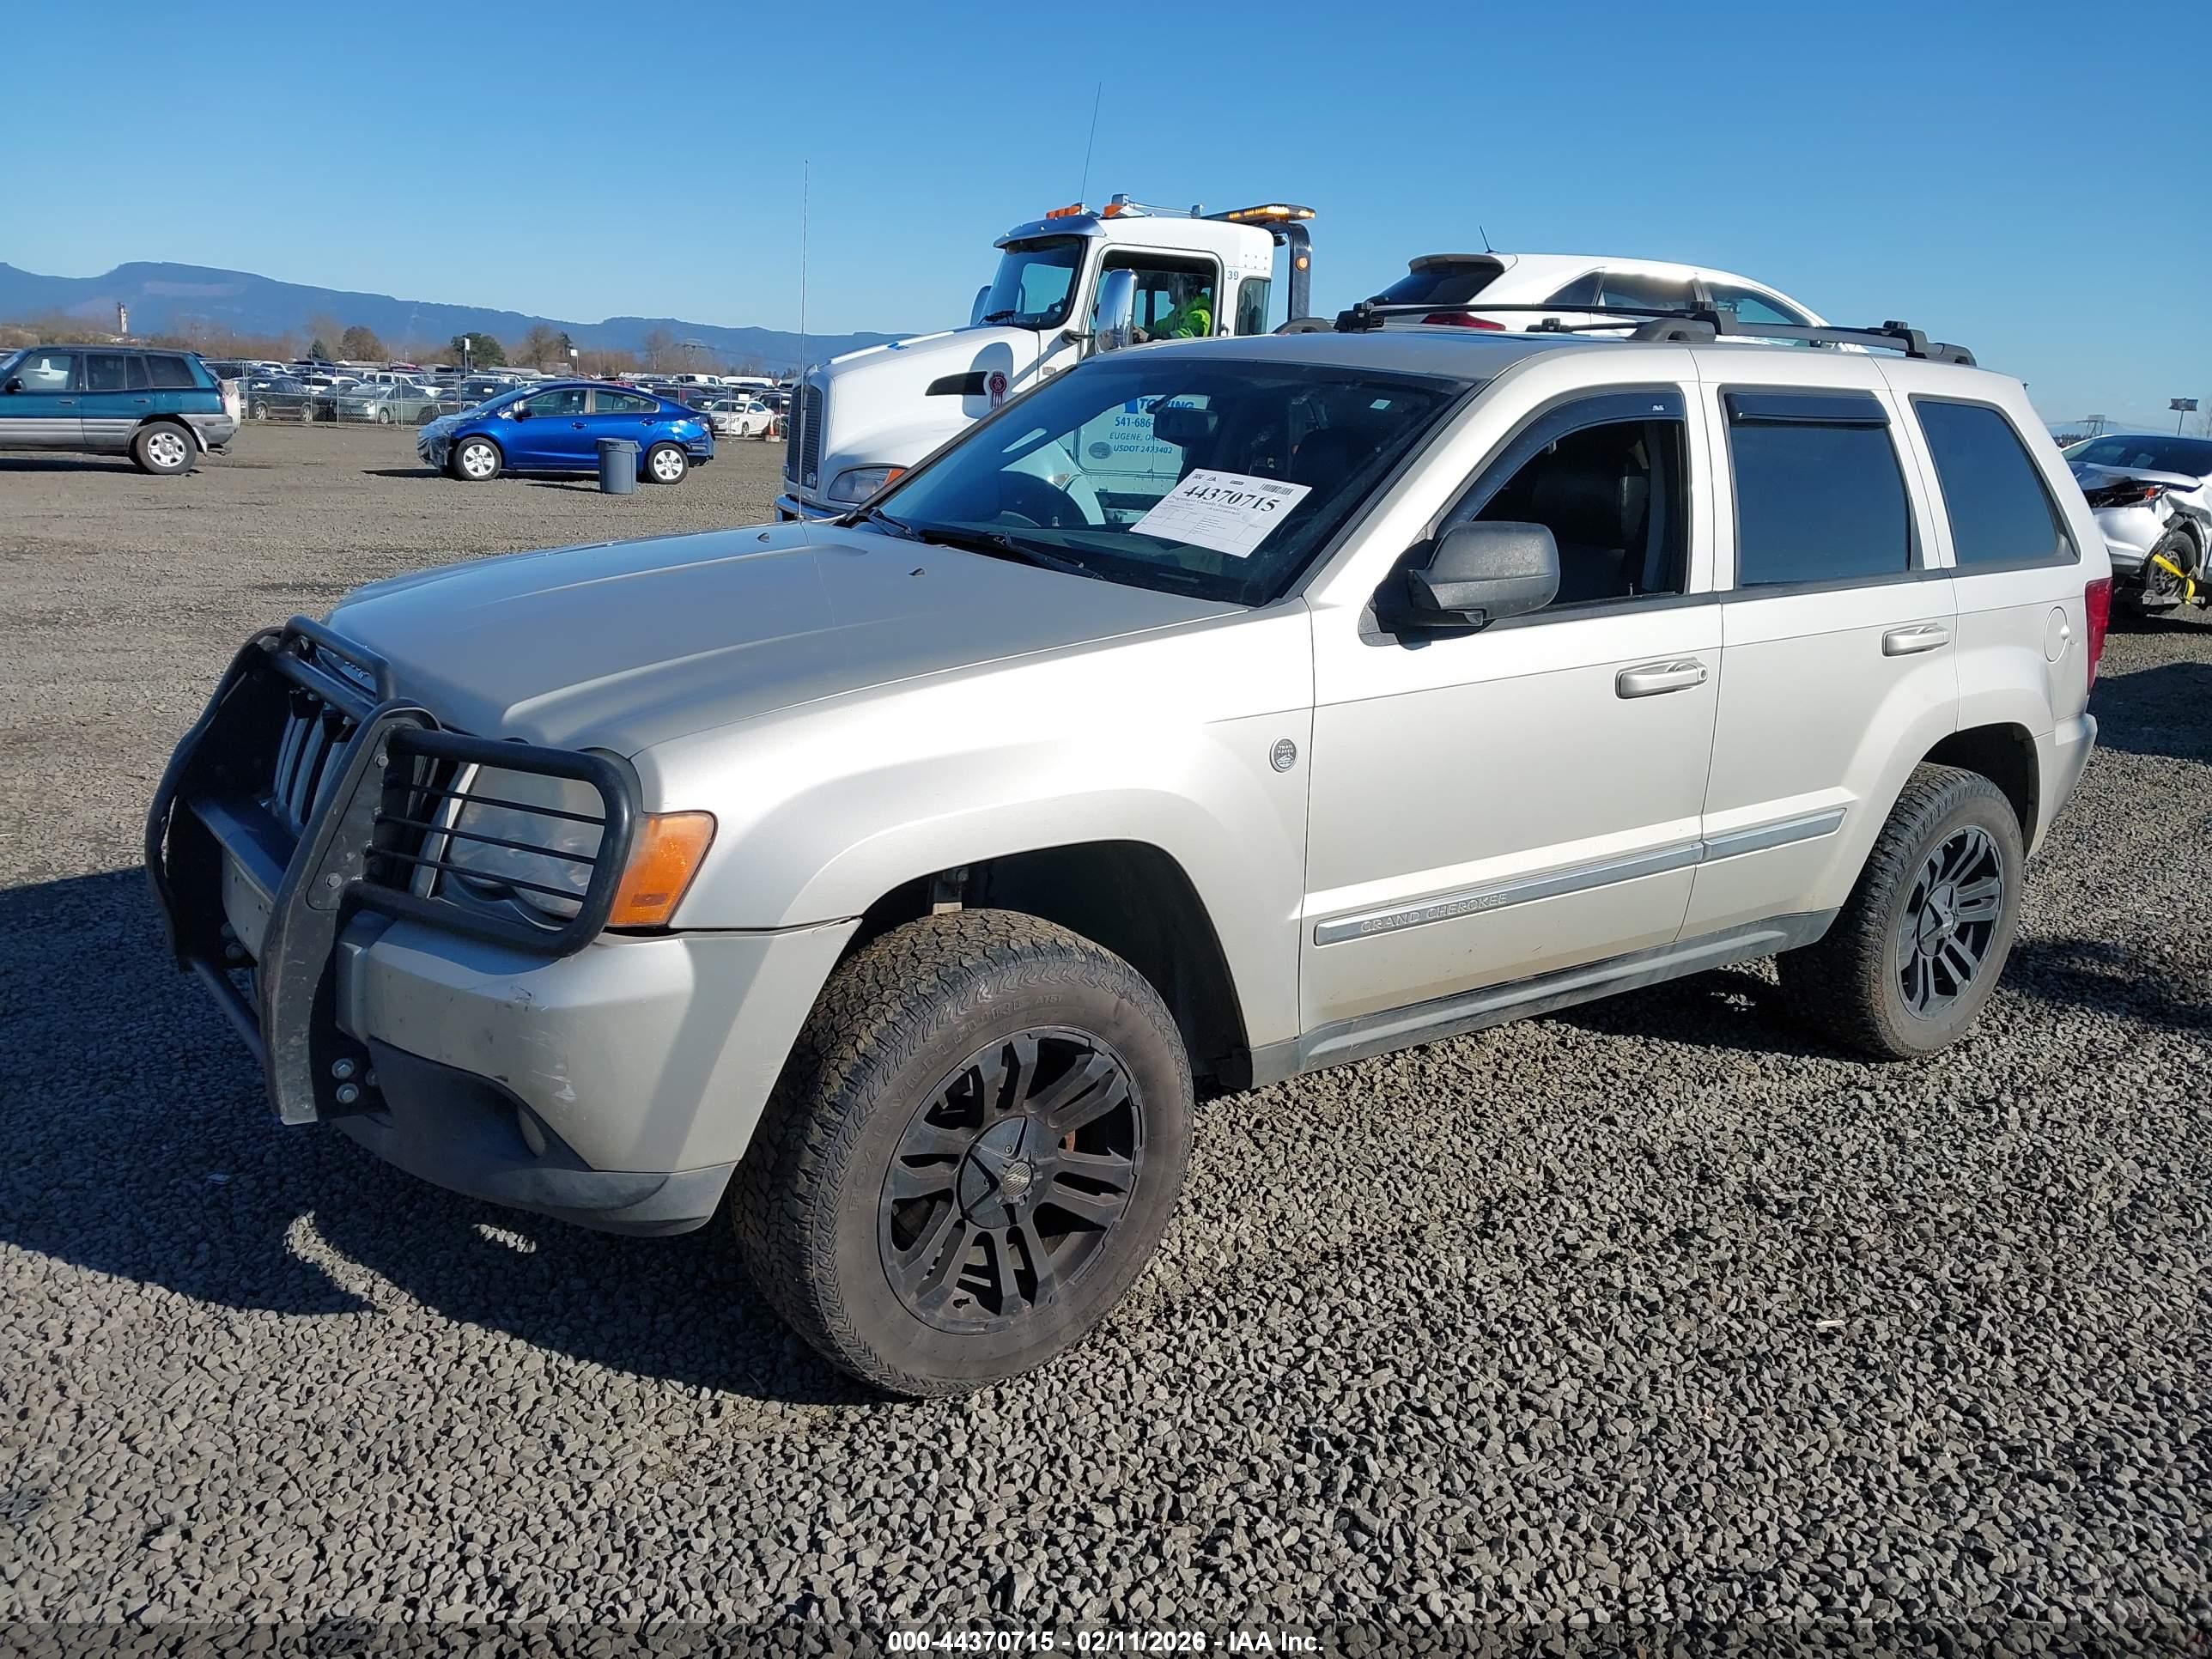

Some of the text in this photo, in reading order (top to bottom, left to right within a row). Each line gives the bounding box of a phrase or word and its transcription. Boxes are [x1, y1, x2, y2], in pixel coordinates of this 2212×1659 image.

[1227, 270, 1239, 280] 39
[1183, 485, 1281, 512] 44370715
[1361, 893, 1508, 933] GRAND CHEROKEE
